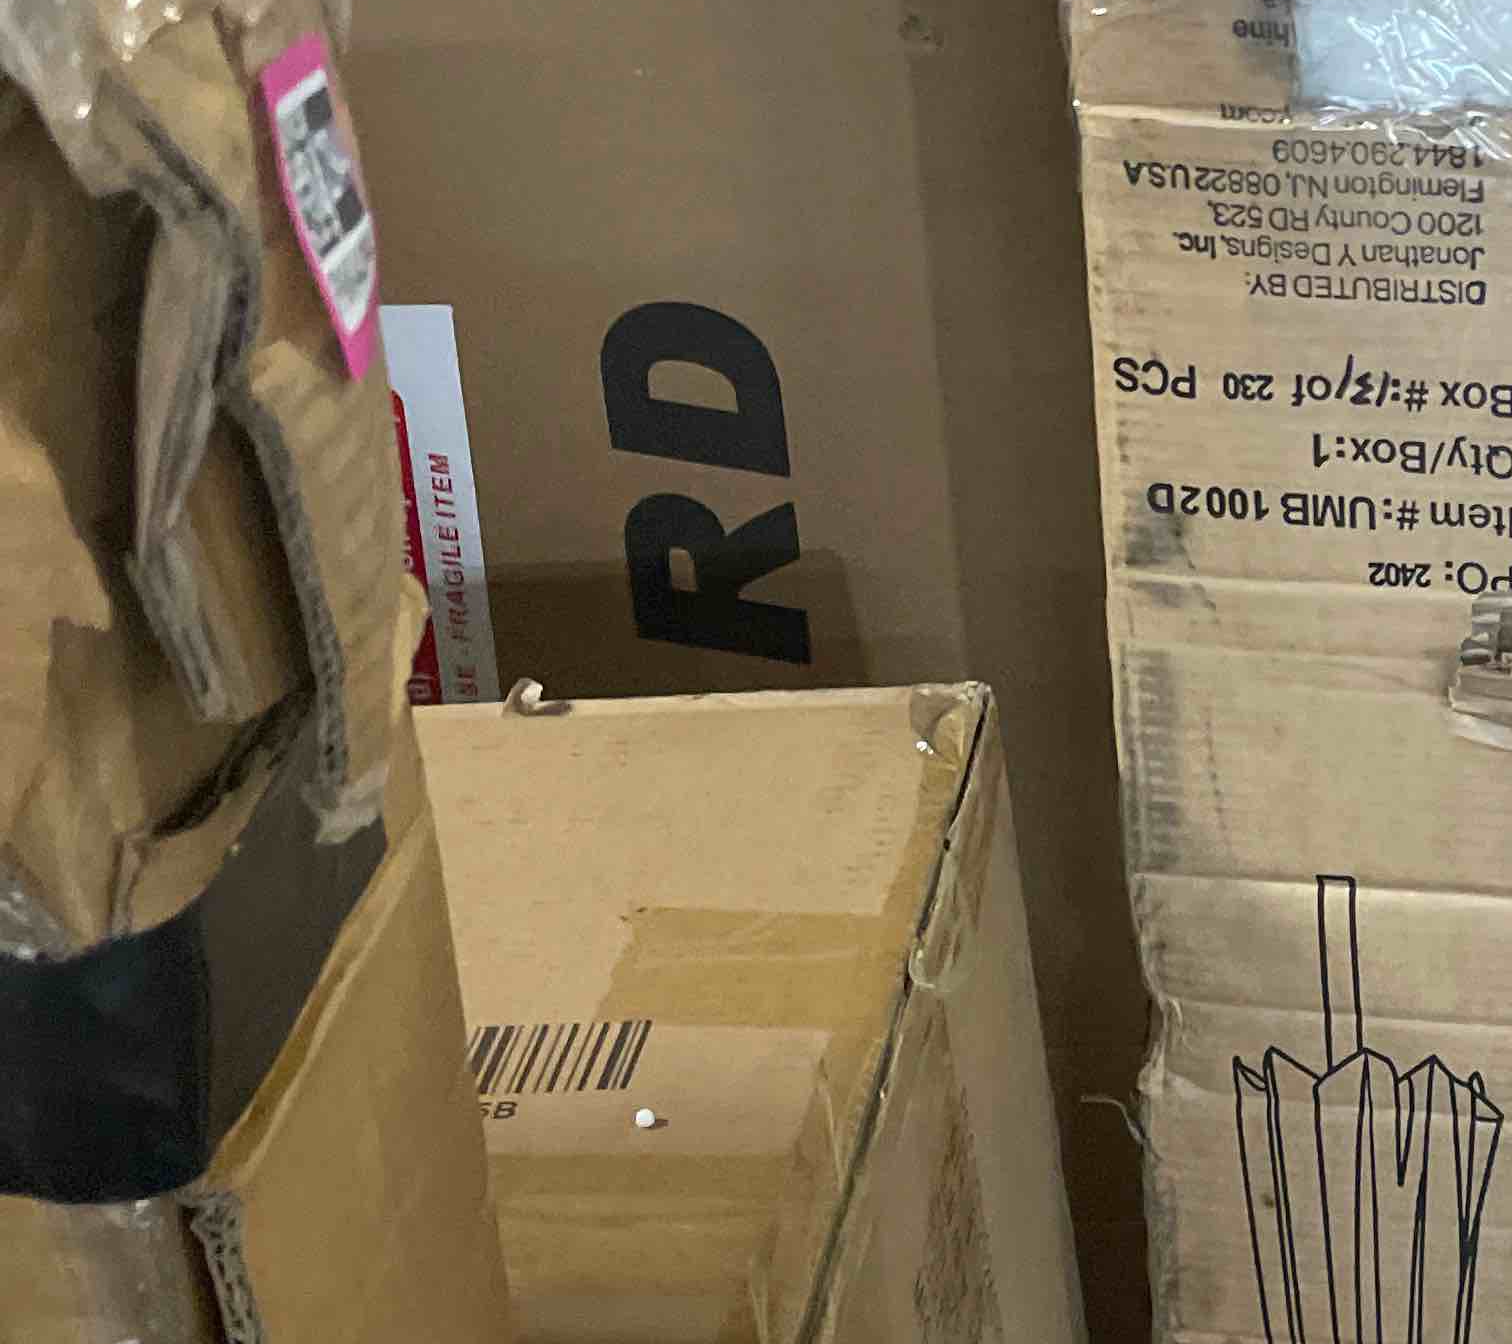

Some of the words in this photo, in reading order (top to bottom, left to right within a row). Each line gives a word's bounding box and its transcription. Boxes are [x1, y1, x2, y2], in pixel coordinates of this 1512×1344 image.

[1194, 167, 1281, 196] 08822
[1335, 172, 1485, 202] Flemington
[1269, 207, 1309, 230] RD
[1316, 206, 1412, 233] County
[1418, 211, 1482, 236] 1200
[1173, 231, 1217, 259] Inc.
[1337, 243, 1358, 265] Y
[1364, 244, 1485, 270] Jonathan
[1244, 273, 1287, 297] BY:
[1293, 275, 1487, 305] DISTRIBUTED
[1112, 357, 1197, 399] PCS
[1222, 372, 1274, 399] 230
[428, 453, 455, 522] ITEM
[600, 301, 812, 665] RD
[437, 526, 471, 641] FRAGILE
[1368, 561, 1431, 587] 2402
